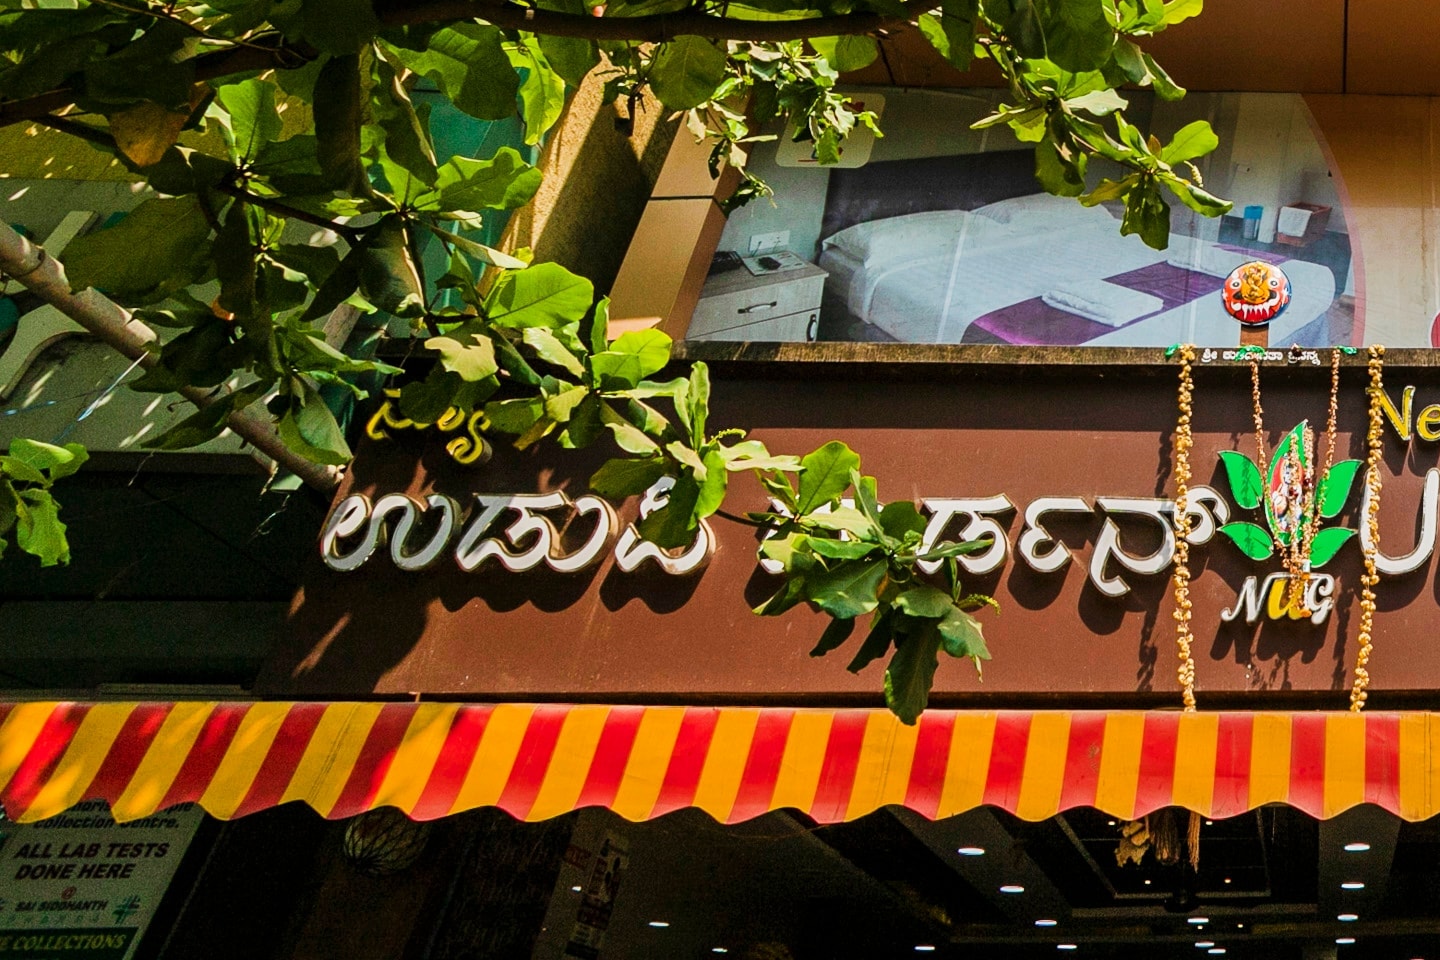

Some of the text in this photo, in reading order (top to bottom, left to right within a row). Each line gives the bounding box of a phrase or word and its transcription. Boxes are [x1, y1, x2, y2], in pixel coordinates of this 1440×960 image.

[14, 842, 171, 859] ALL LAB TESTS
[15, 862, 137, 880] DONE HERE
